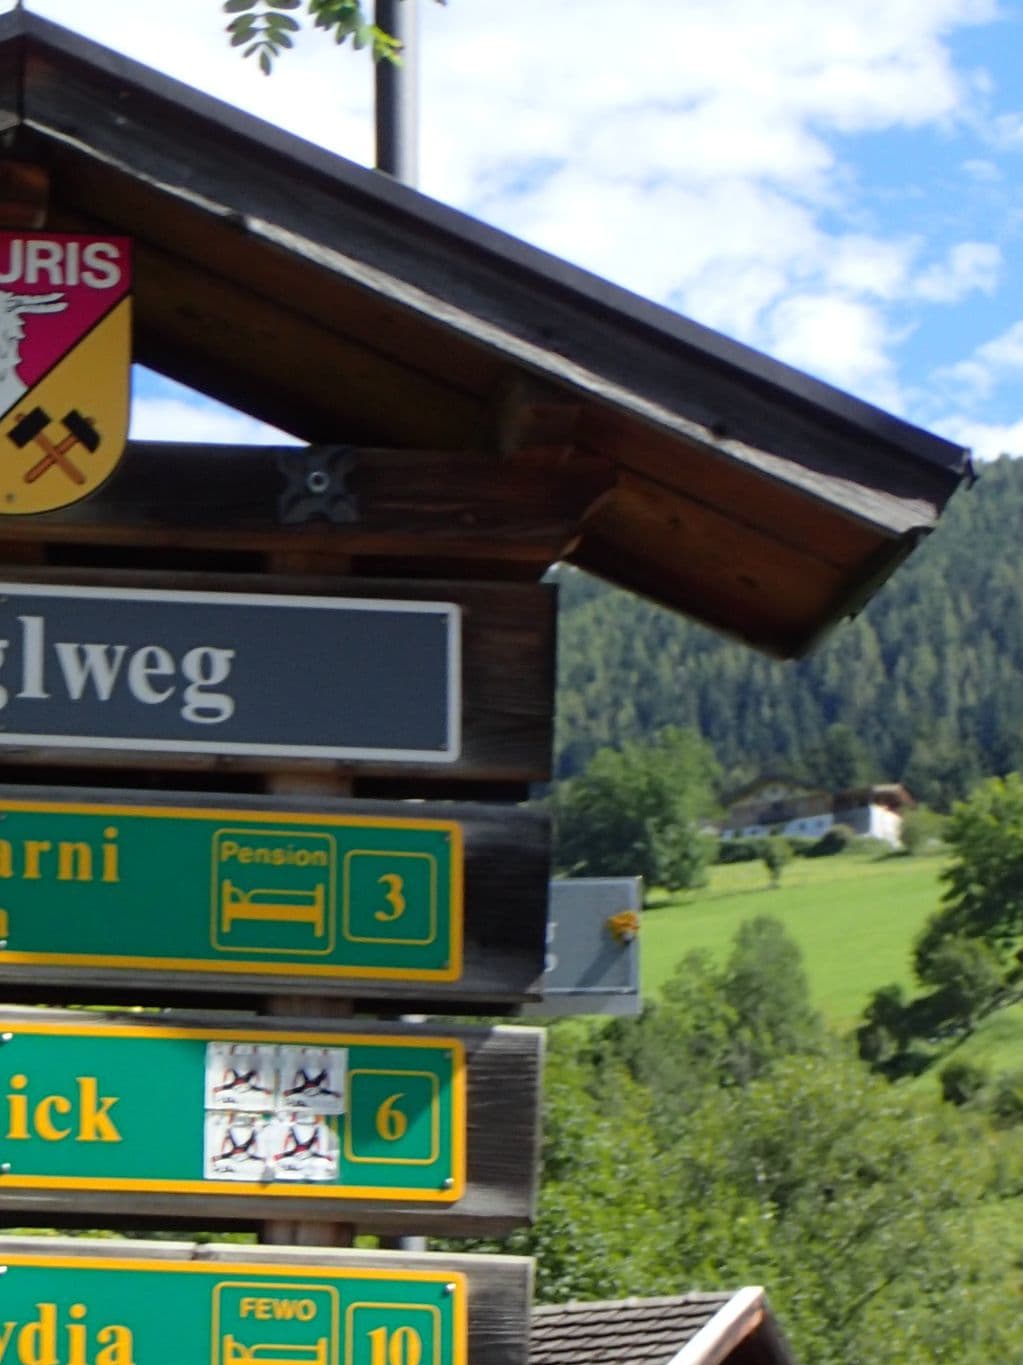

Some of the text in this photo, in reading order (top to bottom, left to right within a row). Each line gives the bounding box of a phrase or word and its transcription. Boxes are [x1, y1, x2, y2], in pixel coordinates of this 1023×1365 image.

[220, 841, 328, 866] Pension
[374, 873, 406, 921] 3
[376, 1093, 407, 1141] 6
[239, 1297, 317, 1322] FEWO
